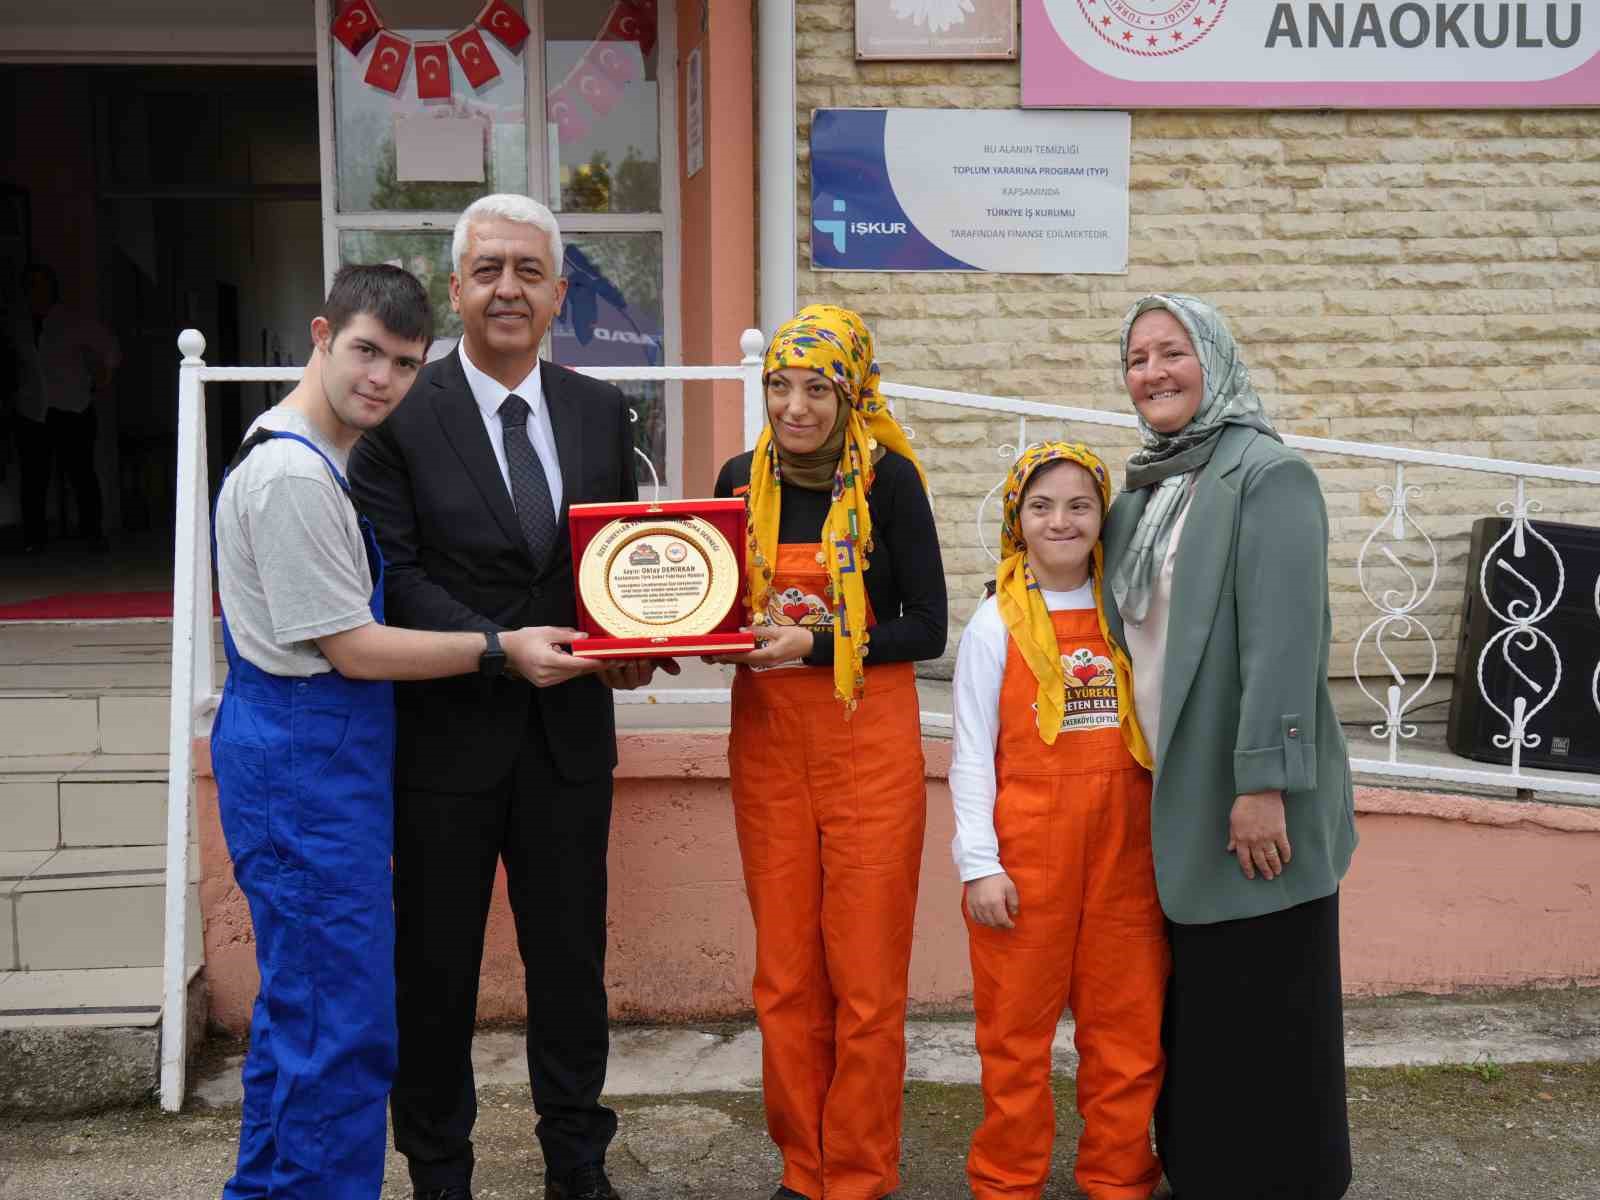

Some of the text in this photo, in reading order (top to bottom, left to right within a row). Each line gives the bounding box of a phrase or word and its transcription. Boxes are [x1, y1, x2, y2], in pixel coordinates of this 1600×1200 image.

[1264, 2, 1582, 48] ANAOKULU
[984, 143, 1080, 155] BU ALANIN TEMİZLİĞİ
[952, 166, 1109, 177] TOPLUM YARARINA PROGRAM (TYP)
[1001, 187, 1061, 197] KAPSAMINDA
[986, 207, 1076, 220] TÜRKİYE İŞ KURUMU
[951, 229, 1007, 240] TARAFINDAN
